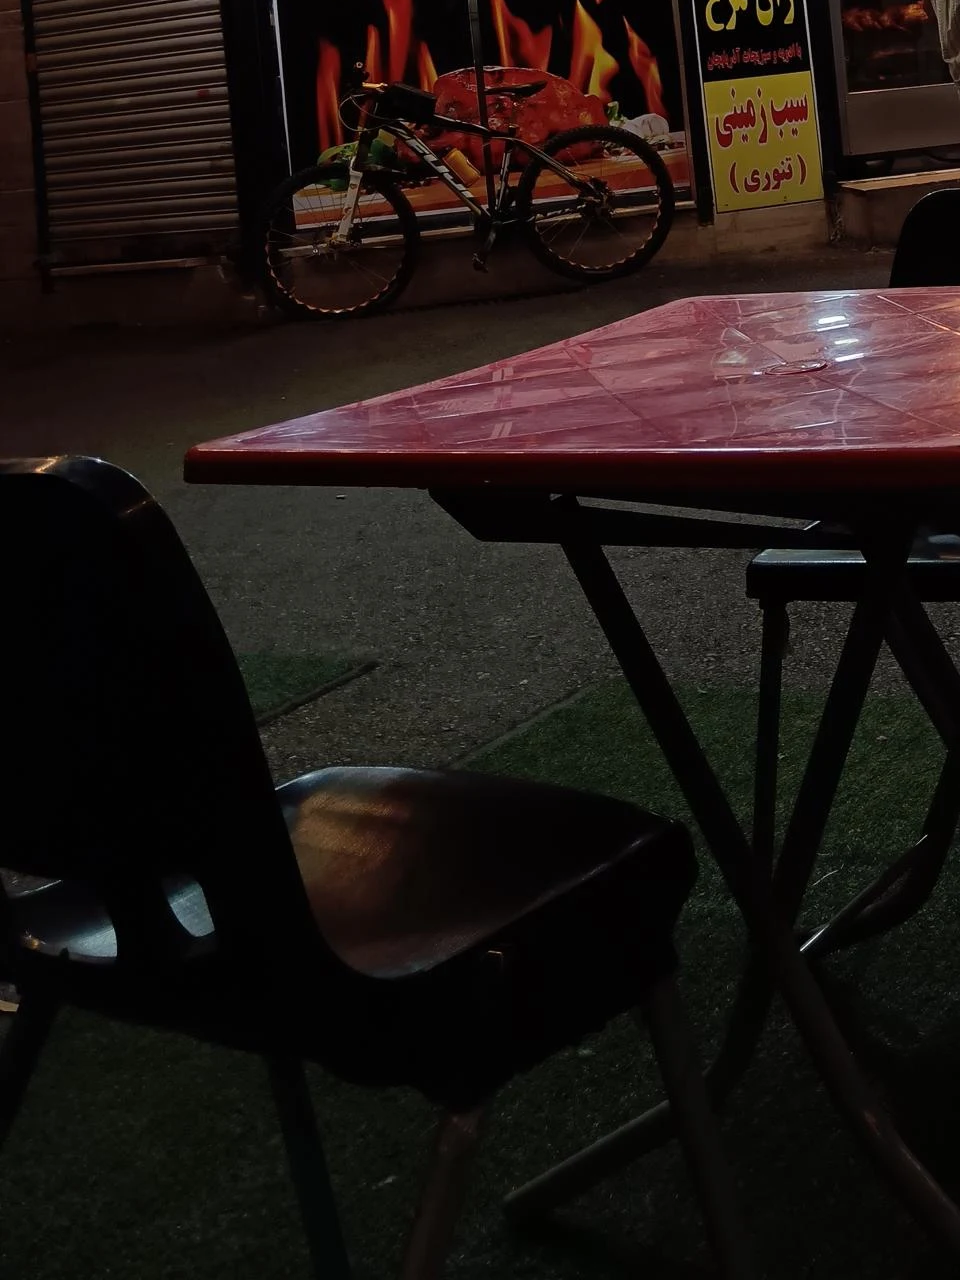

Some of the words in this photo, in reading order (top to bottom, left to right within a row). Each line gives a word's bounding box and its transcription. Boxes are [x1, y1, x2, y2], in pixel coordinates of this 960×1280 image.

[715, 80, 768, 150] زمینی
[768, 86, 809, 138] سیب
[404, 138, 475, 198] FUJI
